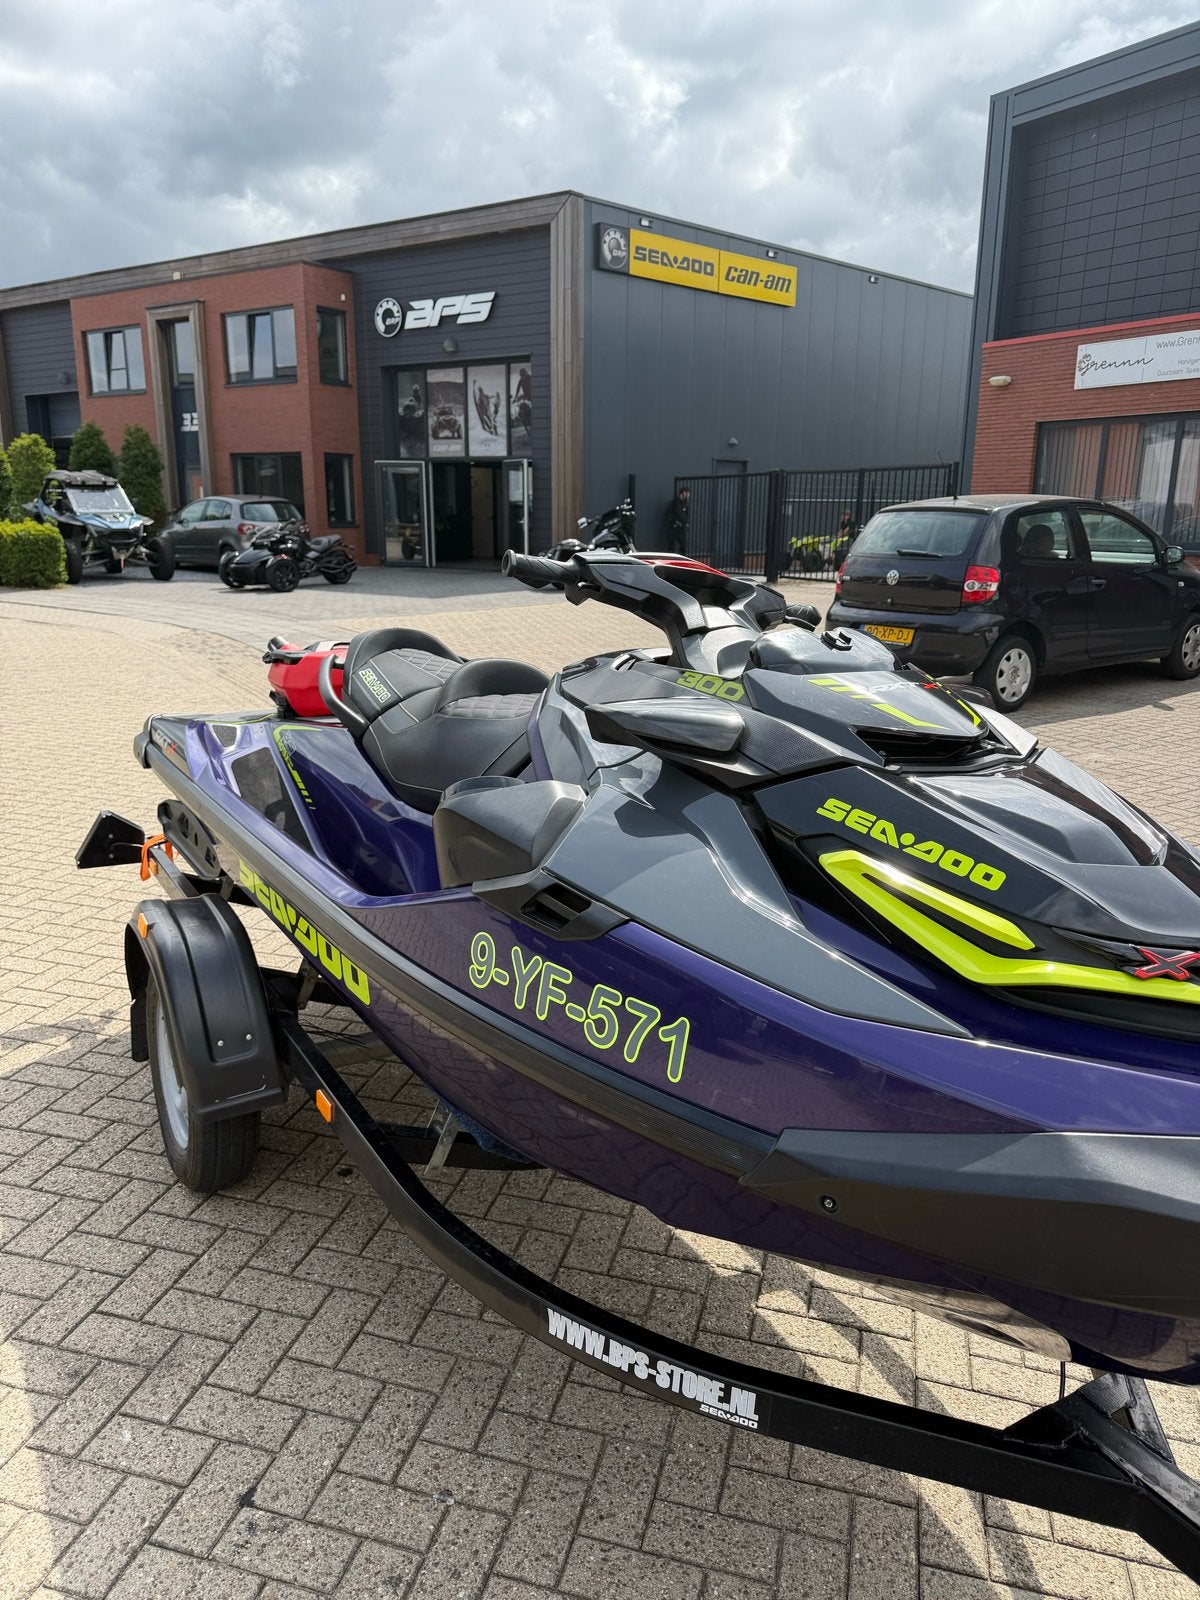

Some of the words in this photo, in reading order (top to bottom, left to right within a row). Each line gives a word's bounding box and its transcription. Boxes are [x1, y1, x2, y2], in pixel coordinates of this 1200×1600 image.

[677, 671, 745, 702] 300
[469, 931, 691, 1083] 9-YF-571
[547, 1308, 759, 1421] WWW.BPS-STORE.NL
